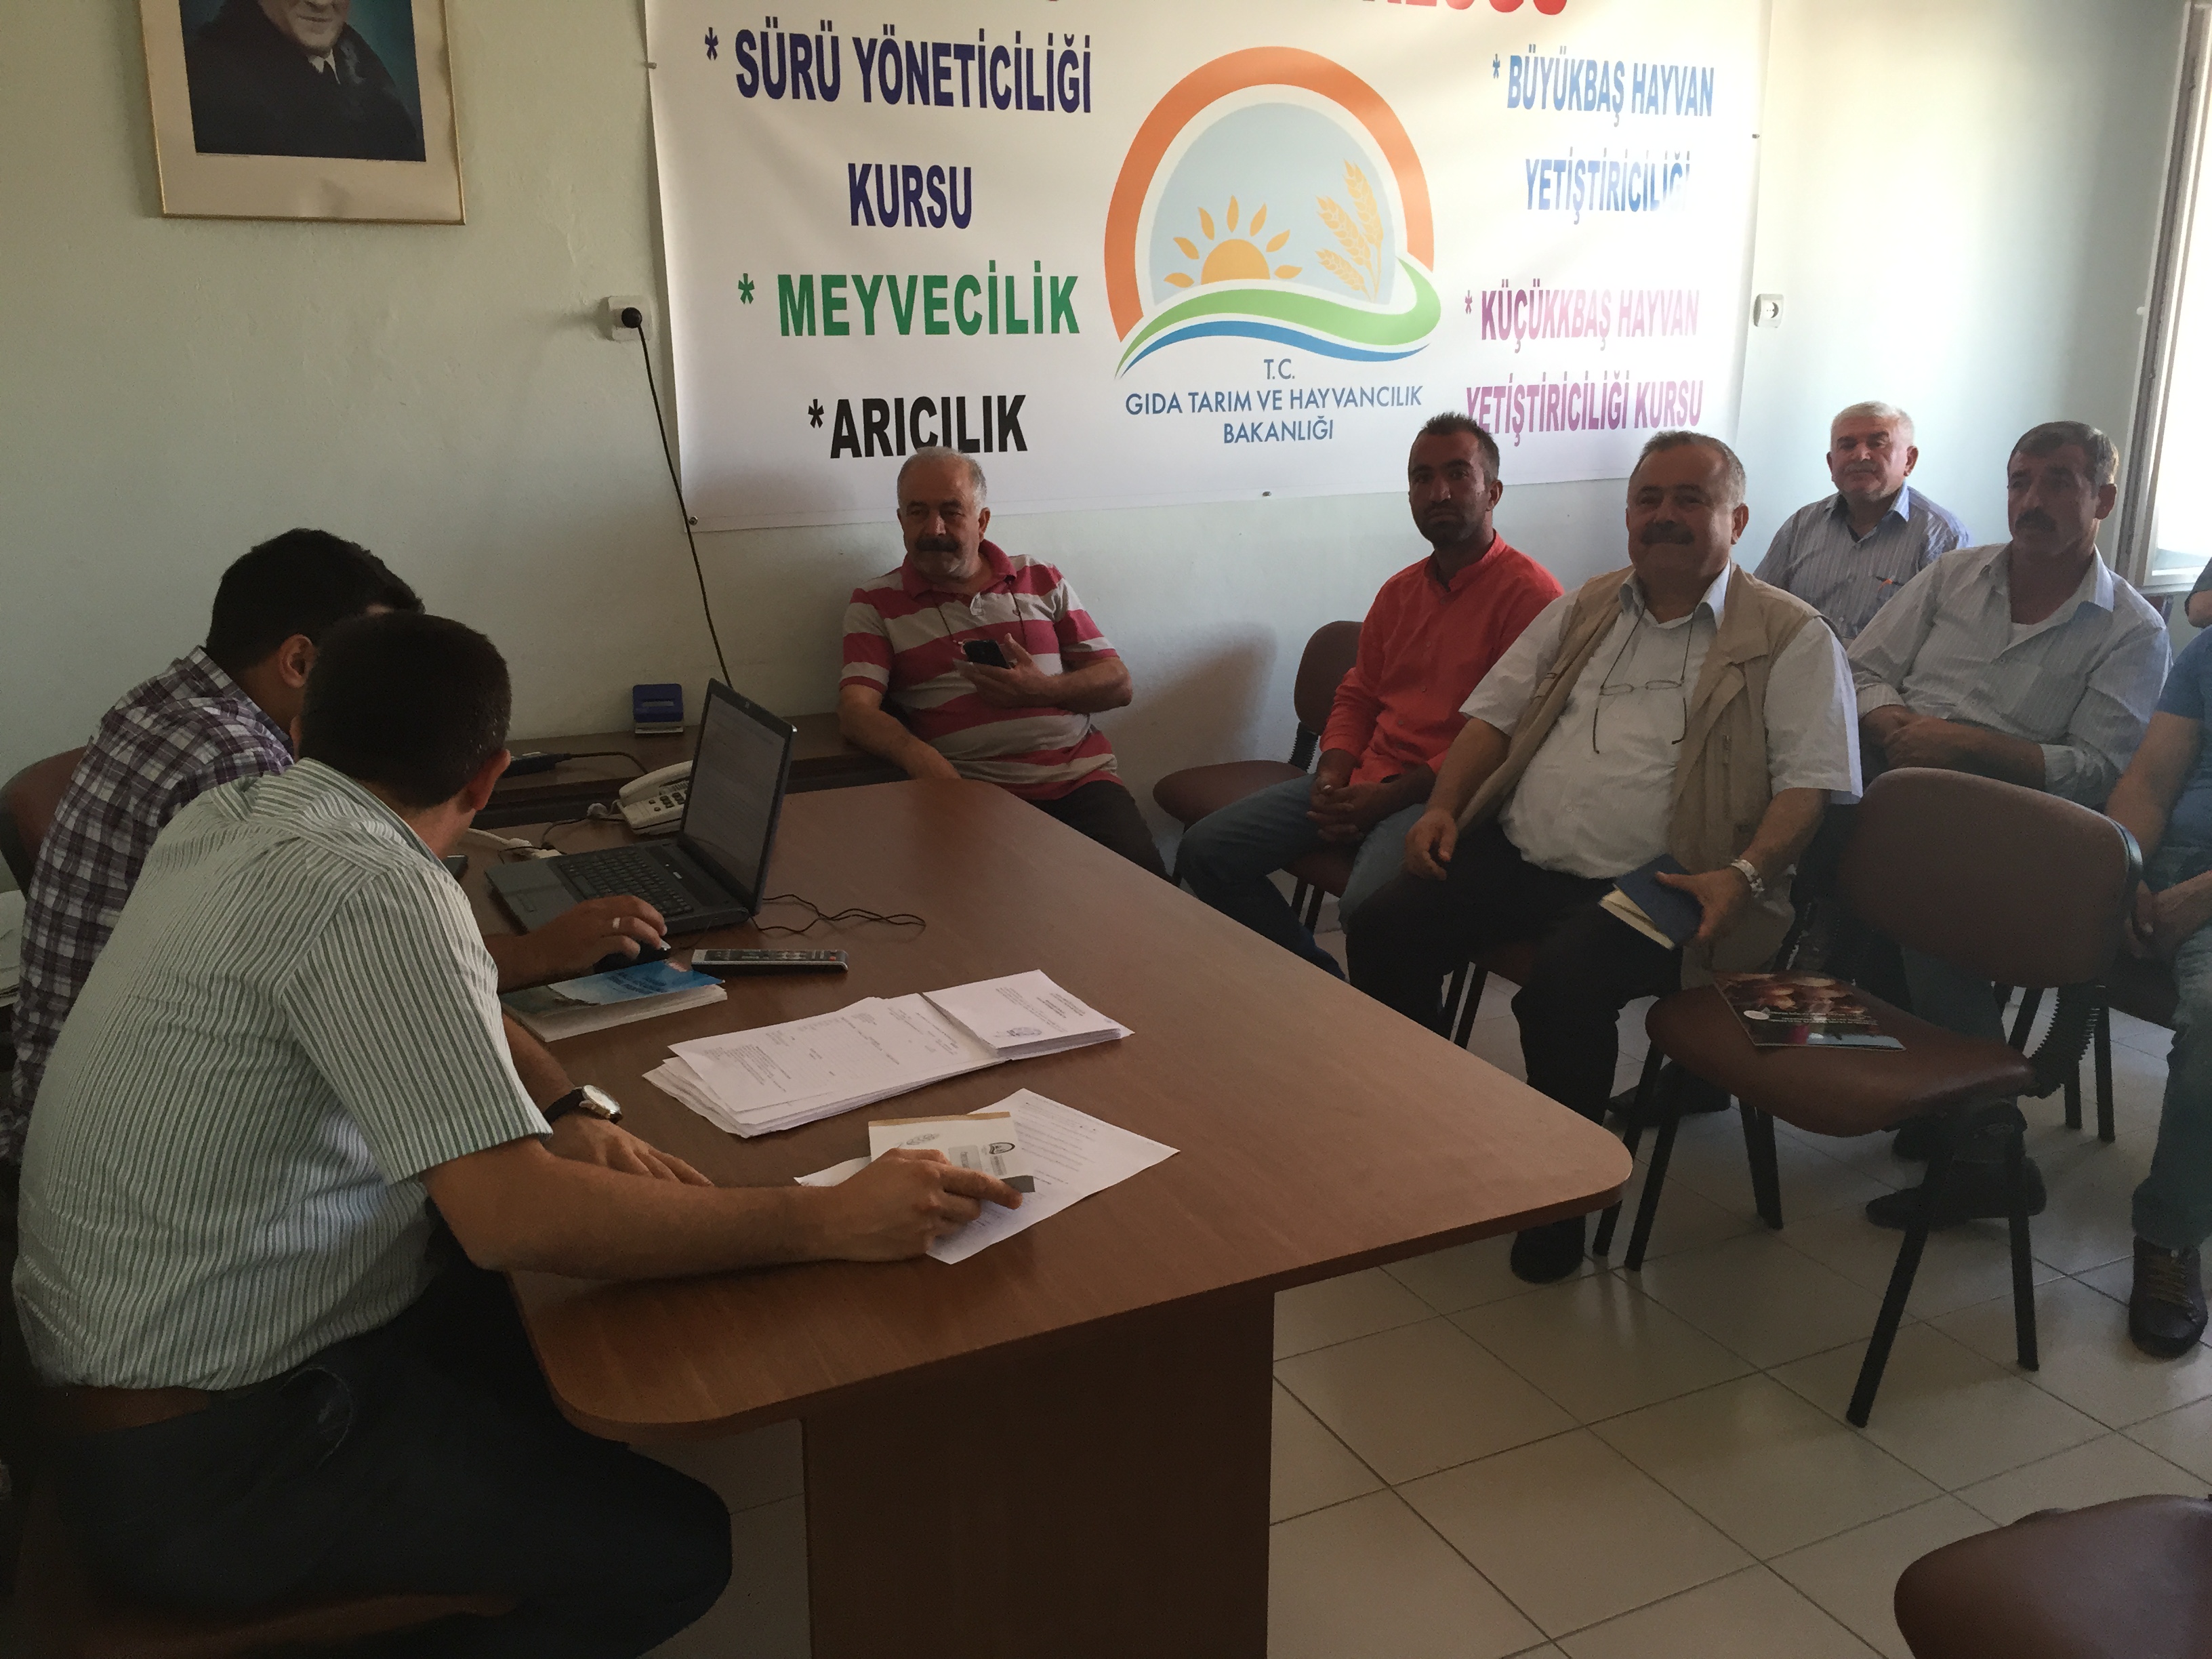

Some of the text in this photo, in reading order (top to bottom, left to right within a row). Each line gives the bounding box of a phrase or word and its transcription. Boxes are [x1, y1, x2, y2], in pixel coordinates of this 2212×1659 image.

[735, 16, 1091, 114] SÜRÜ YÖNETİCİLİĞİ
[1507, 43, 1715, 127] BÜYÜKBAŞ HAYVAN
[847, 162, 972, 230] KURSU
[777, 260, 1080, 337] MEYVECİLİK
[1618, 289, 1700, 337] HAYVAN
[1125, 386, 1424, 415] GIDA TARIM VE HAYVANCILIK
[1263, 359, 1295, 380] T.C.
[1223, 415, 1334, 444] BAKANLIĞI
[1466, 370, 1704, 447] YETİŞTİRİCİLİĞİ KURSU
